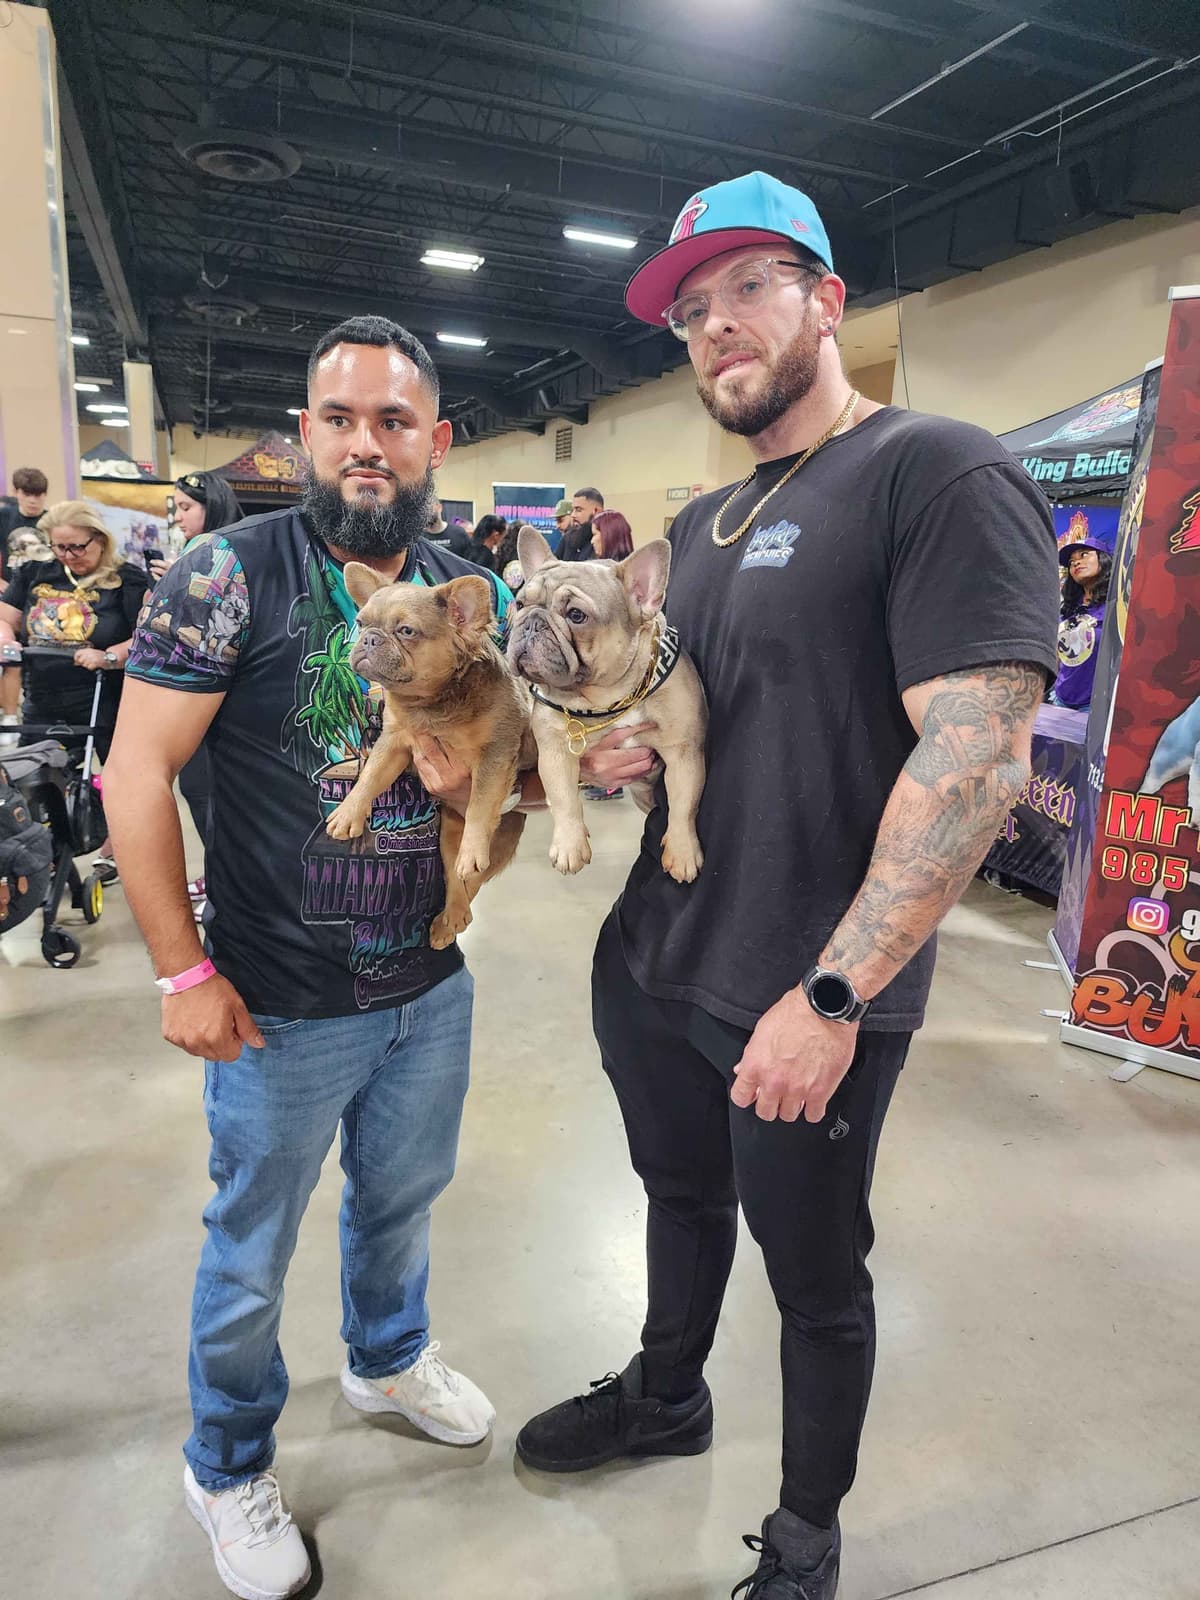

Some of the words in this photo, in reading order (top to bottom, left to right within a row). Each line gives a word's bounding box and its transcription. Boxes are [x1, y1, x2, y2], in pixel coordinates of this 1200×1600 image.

[1021, 457, 1068, 482] King
[1105, 790, 1191, 847] Mr
[304, 856, 408, 916] MIAMI'S
[1101, 846, 1190, 892] 985
